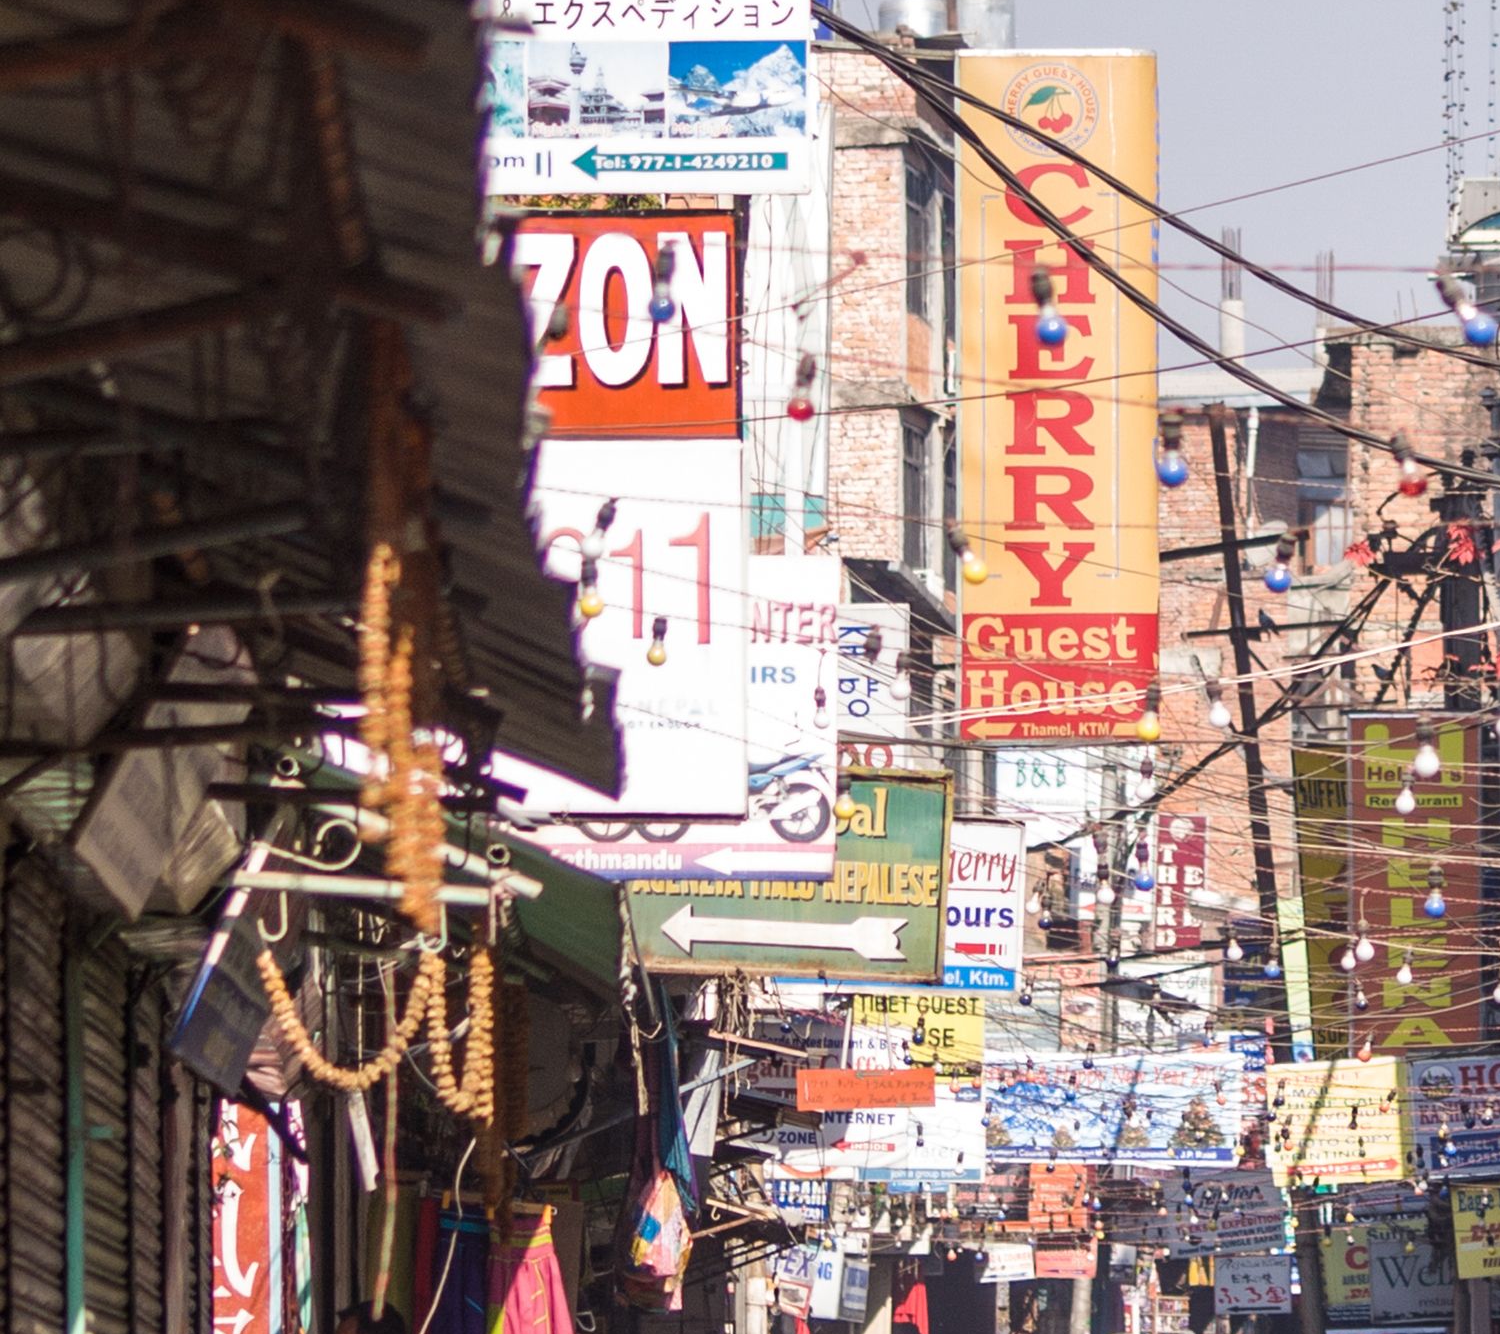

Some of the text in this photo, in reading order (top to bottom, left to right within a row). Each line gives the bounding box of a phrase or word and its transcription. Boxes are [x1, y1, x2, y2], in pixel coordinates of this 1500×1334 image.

[592, 155, 627, 170] Tel:
[629, 154, 774, 170] 977-1-4249210
[1003, 163, 1096, 607] CHERRY
[965, 616, 1138, 661] Guest
[964, 670, 1140, 717] House
[1020, 721, 1111, 738] Thamel, KTM
[1368, 795, 1460, 808] Resurant
[822, 860, 939, 907] NEPALESE
[1155, 843, 1178, 947] THIRD
[968, 969, 1010, 987] Ktm.
[859, 994, 980, 1015] TIBET GUEST
[822, 1110, 896, 1126] NTERNET
[777, 1130, 817, 1145] ZONE
